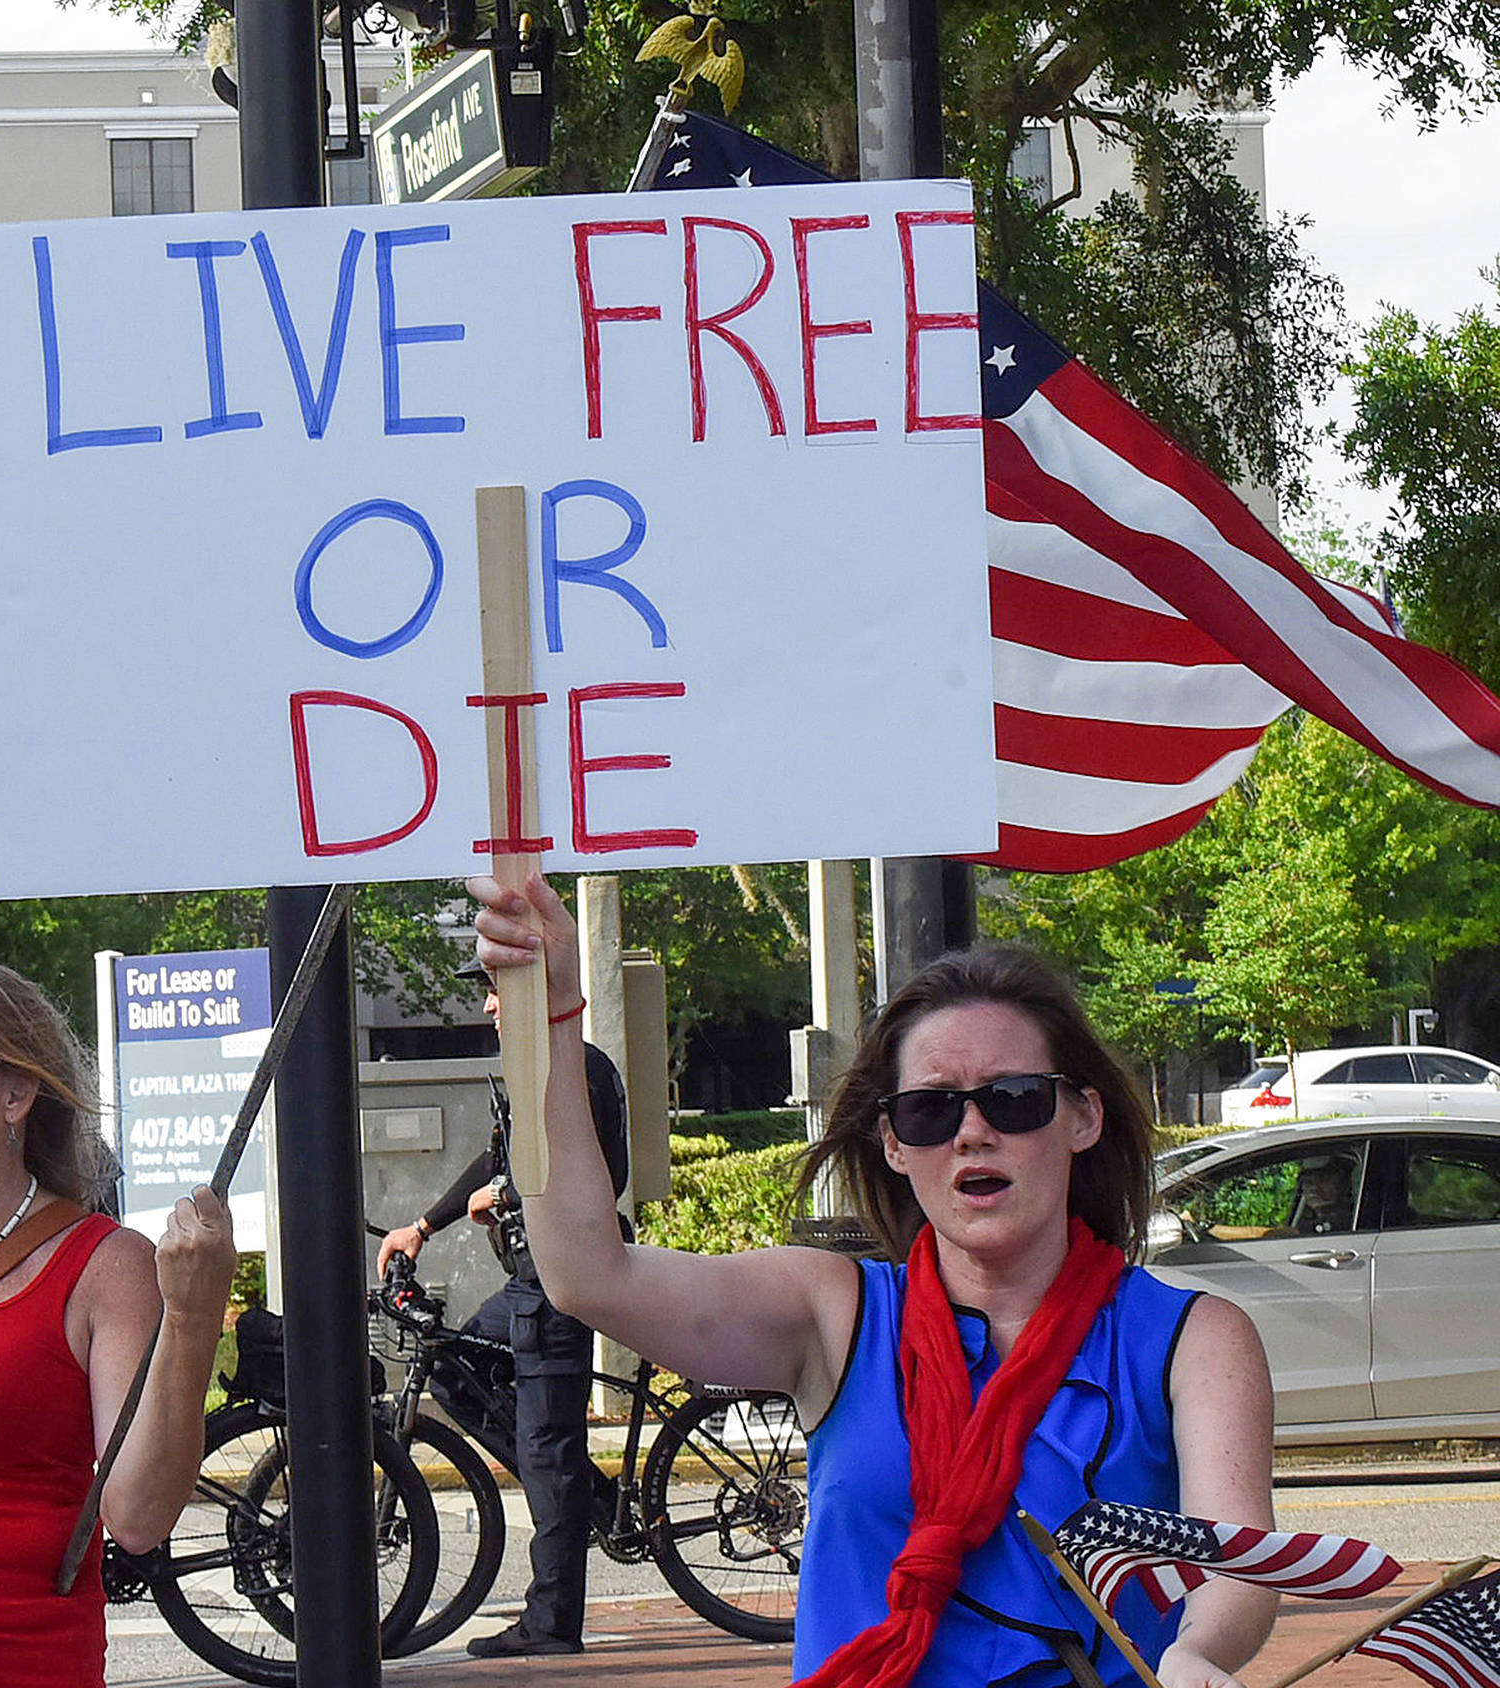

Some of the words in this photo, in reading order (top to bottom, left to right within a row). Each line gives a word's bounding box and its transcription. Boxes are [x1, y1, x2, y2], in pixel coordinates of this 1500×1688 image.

[400, 97, 463, 195] Rosalind
[463, 81, 483, 124] AVE
[33, 225, 466, 456] LIVE
[571, 211, 984, 443] FREE
[294, 478, 669, 660] OR
[289, 682, 700, 859] DIE
[126, 968, 158, 996] For
[160, 966, 213, 994] Lease
[215, 968, 237, 992] or
[128, 1000, 176, 1031] Build
[177, 999, 202, 1028] To
[203, 996, 241, 1026] Suit
[129, 1075, 181, 1096] CAPITAL
[182, 1072, 224, 1094] PLAZA
[224, 1071, 255, 1092] THR
[129, 1114, 263, 1148] 407.849.2
